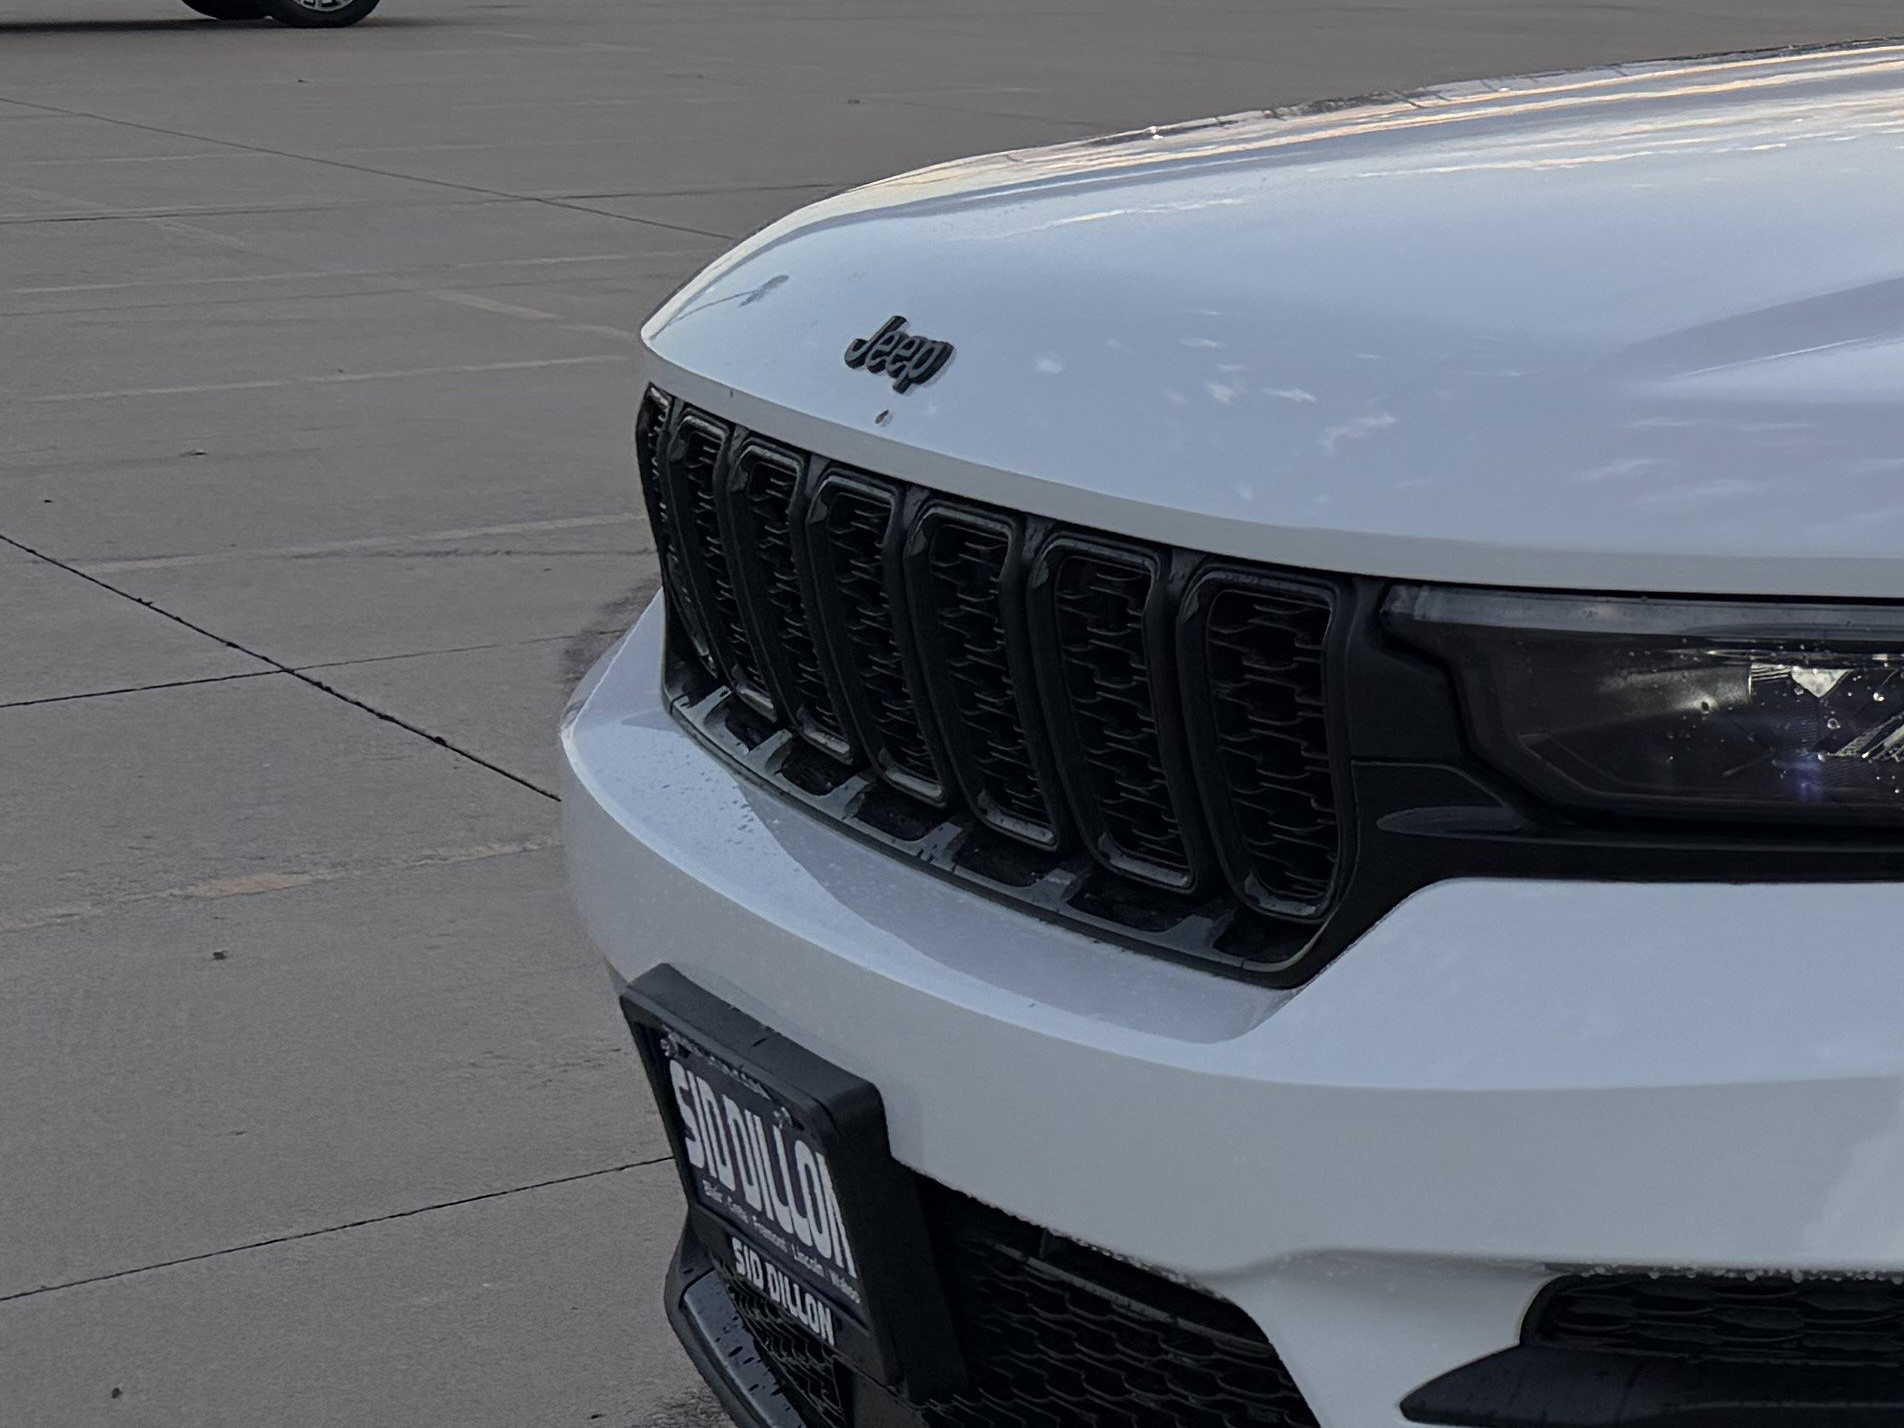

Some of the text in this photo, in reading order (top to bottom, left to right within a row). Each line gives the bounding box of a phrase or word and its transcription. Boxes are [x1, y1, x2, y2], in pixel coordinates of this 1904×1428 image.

[844, 315, 954, 394] Jeep
[669, 1059, 858, 1280] SID DILLON
[731, 1236, 764, 1291] SID
[767, 1260, 836, 1347] DILLON
